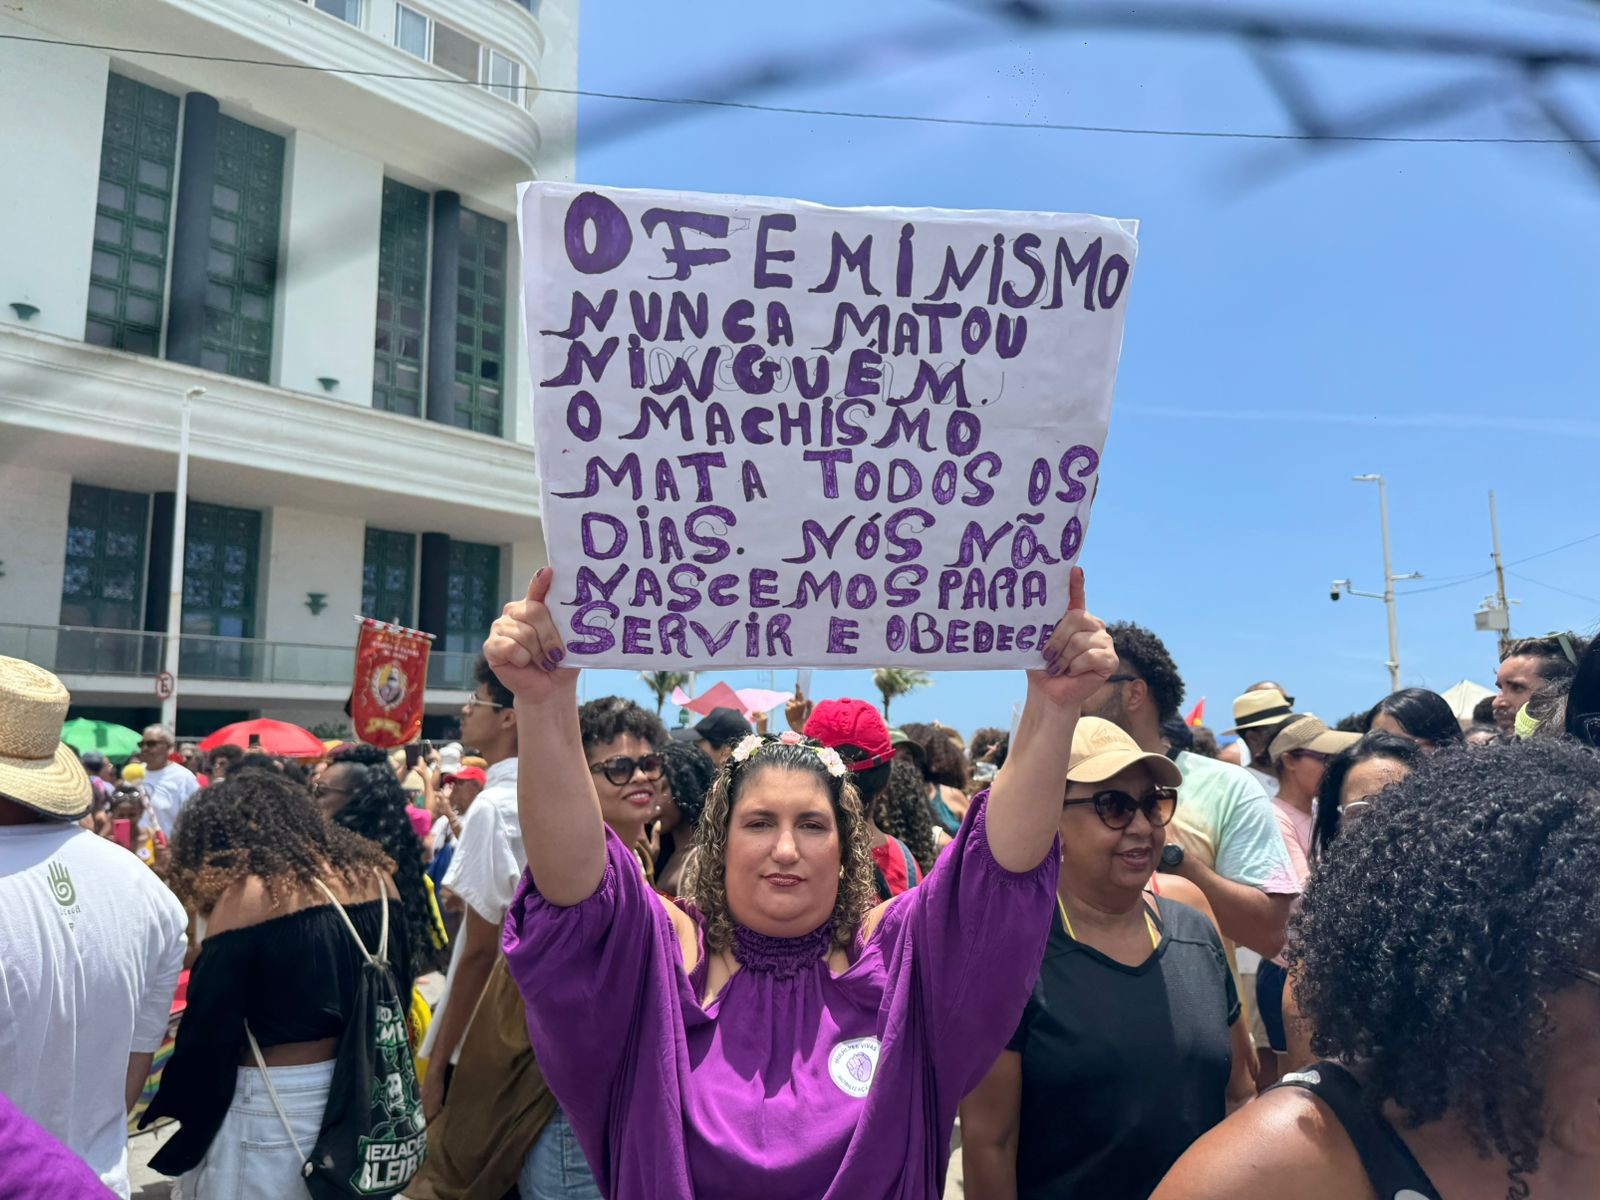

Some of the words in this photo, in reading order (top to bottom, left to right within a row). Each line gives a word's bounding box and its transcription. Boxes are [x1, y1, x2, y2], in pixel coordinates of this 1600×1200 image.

[564, 192, 633, 274] O
[641, 209, 1129, 311] FEMINISMO
[540, 290, 793, 346] NUNCA
[811, 302, 1027, 359] MATOU
[540, 333, 988, 406] NINGUÉM.
[567, 391, 601, 441] O
[619, 397, 981, 456] MACHISMO
[551, 453, 768, 501] MATA
[803, 449, 1002, 506] TODOS
[1028, 445, 1099, 505] OS
[583, 505, 745, 564] DIAS.
[782, 507, 936, 564] NÓS
[945, 513, 1083, 567] NÃO
[561, 563, 929, 613] NASCEMOS
[938, 568, 1047, 610] PARA
[567, 600, 792, 658] SERVIR
[826, 618, 859, 654] E
[887, 612, 1063, 654] OBEDECE
